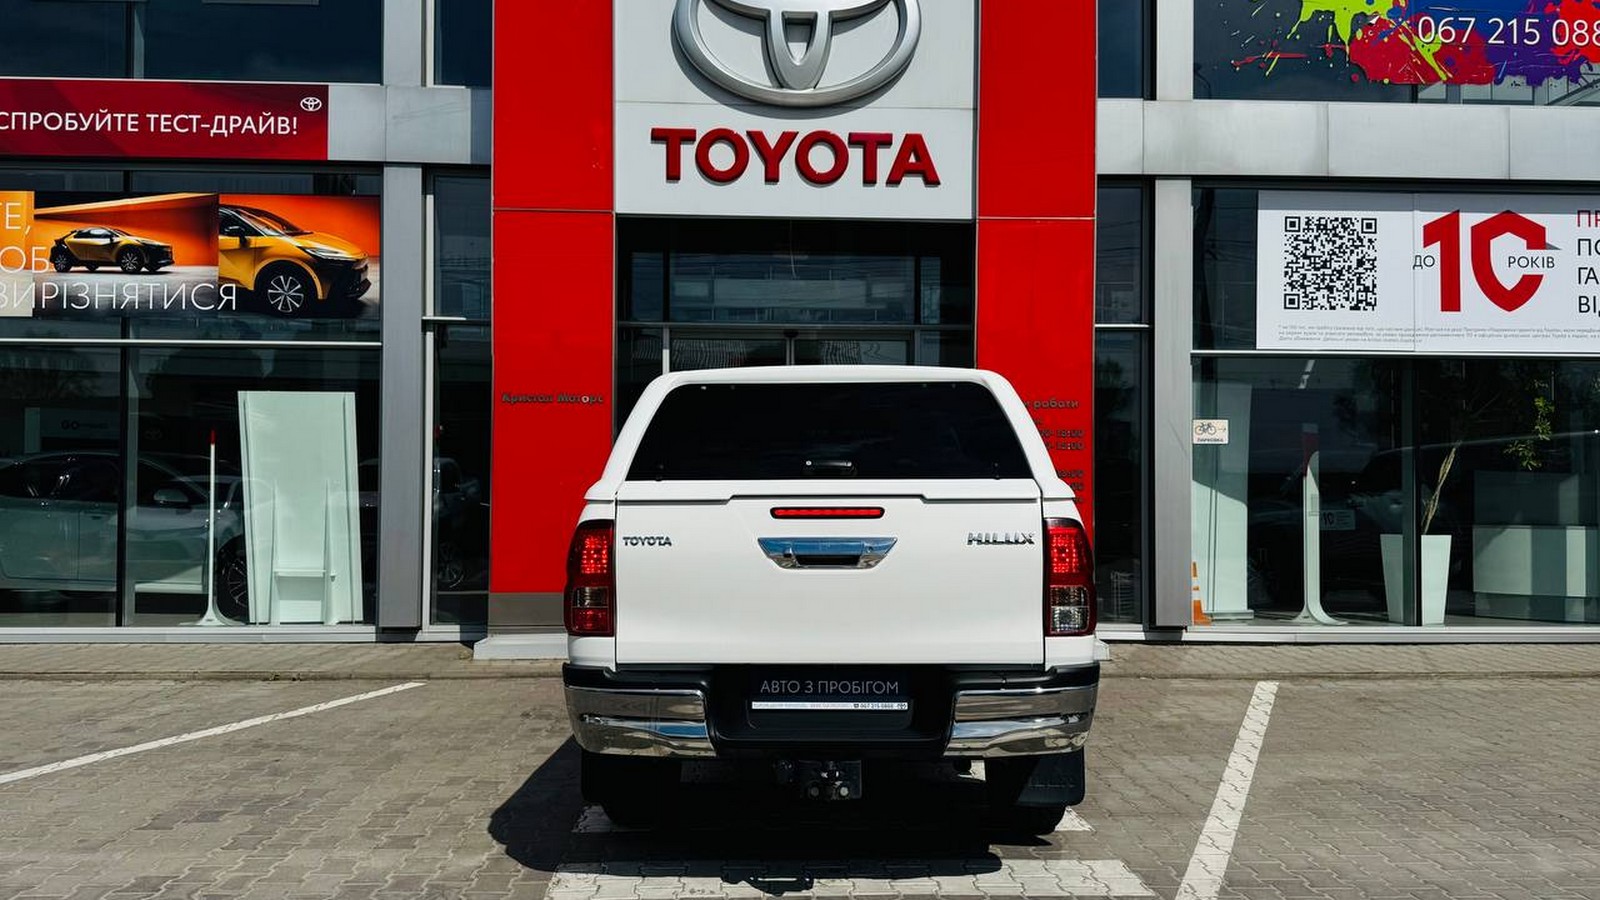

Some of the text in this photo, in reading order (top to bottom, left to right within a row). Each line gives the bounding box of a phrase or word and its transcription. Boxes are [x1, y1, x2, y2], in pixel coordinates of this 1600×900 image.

[1418, 16, 1476, 43] 067
[1488, 17, 1540, 45] 215
[0, 108, 298, 137] СПРОБУЙТЕ ТЕСТ-ДРАЙВ!
[651, 127, 940, 186] TOYOTA
[0, 202, 30, 235] Е,
[1412, 254, 1435, 270] ДО
[1507, 255, 1555, 269] РОКІВ
[1579, 295, 1600, 318] ВІ
[622, 536, 672, 546] TOYOTA
[967, 532, 1035, 545] HILUX
[760, 680, 800, 694] АВТО
[818, 680, 899, 694] ПРОБІГОМ
